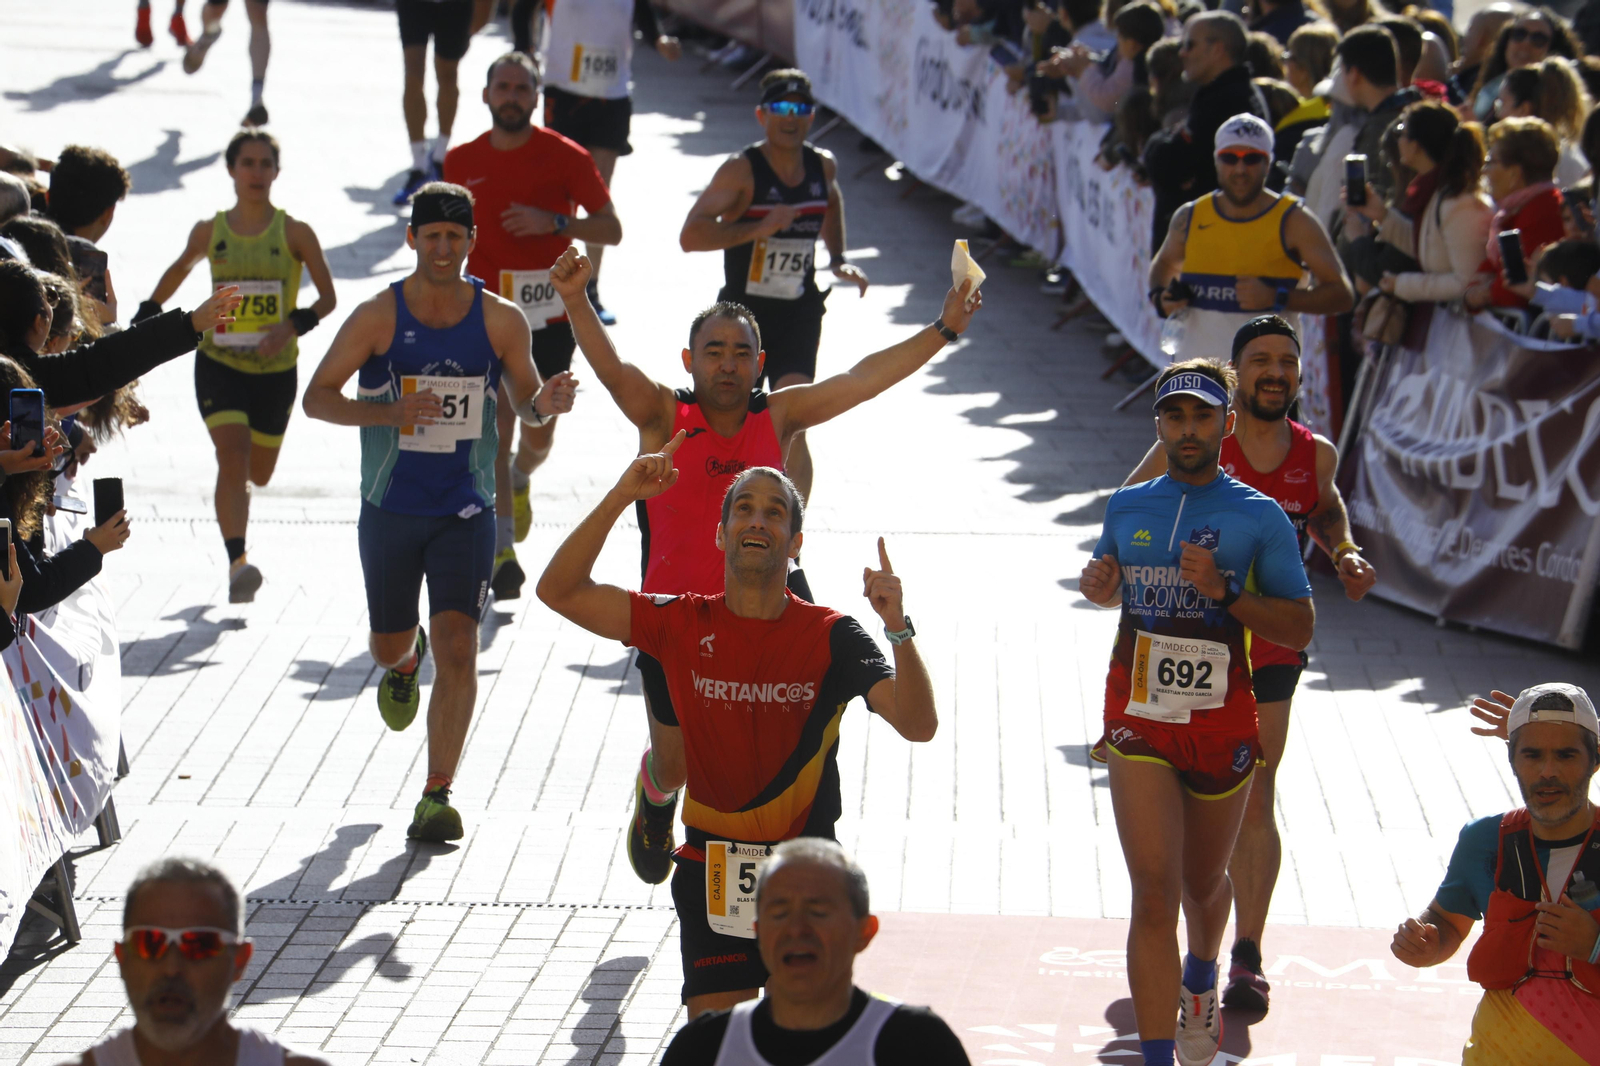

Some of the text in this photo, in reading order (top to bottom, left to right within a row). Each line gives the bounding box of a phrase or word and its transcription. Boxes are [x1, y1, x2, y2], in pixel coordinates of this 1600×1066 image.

[521, 283, 555, 304] 600
[427, 380, 460, 389] IMDECO
[442, 394, 470, 419] 51
[1155, 609, 1171, 618] DEL
[1176, 610, 1205, 619] ALCOR
[1161, 642, 1199, 654] IMDECO
[1157, 657, 1213, 690] 692
[713, 870, 722, 900] CAJÓN
[738, 863, 757, 894] 5
